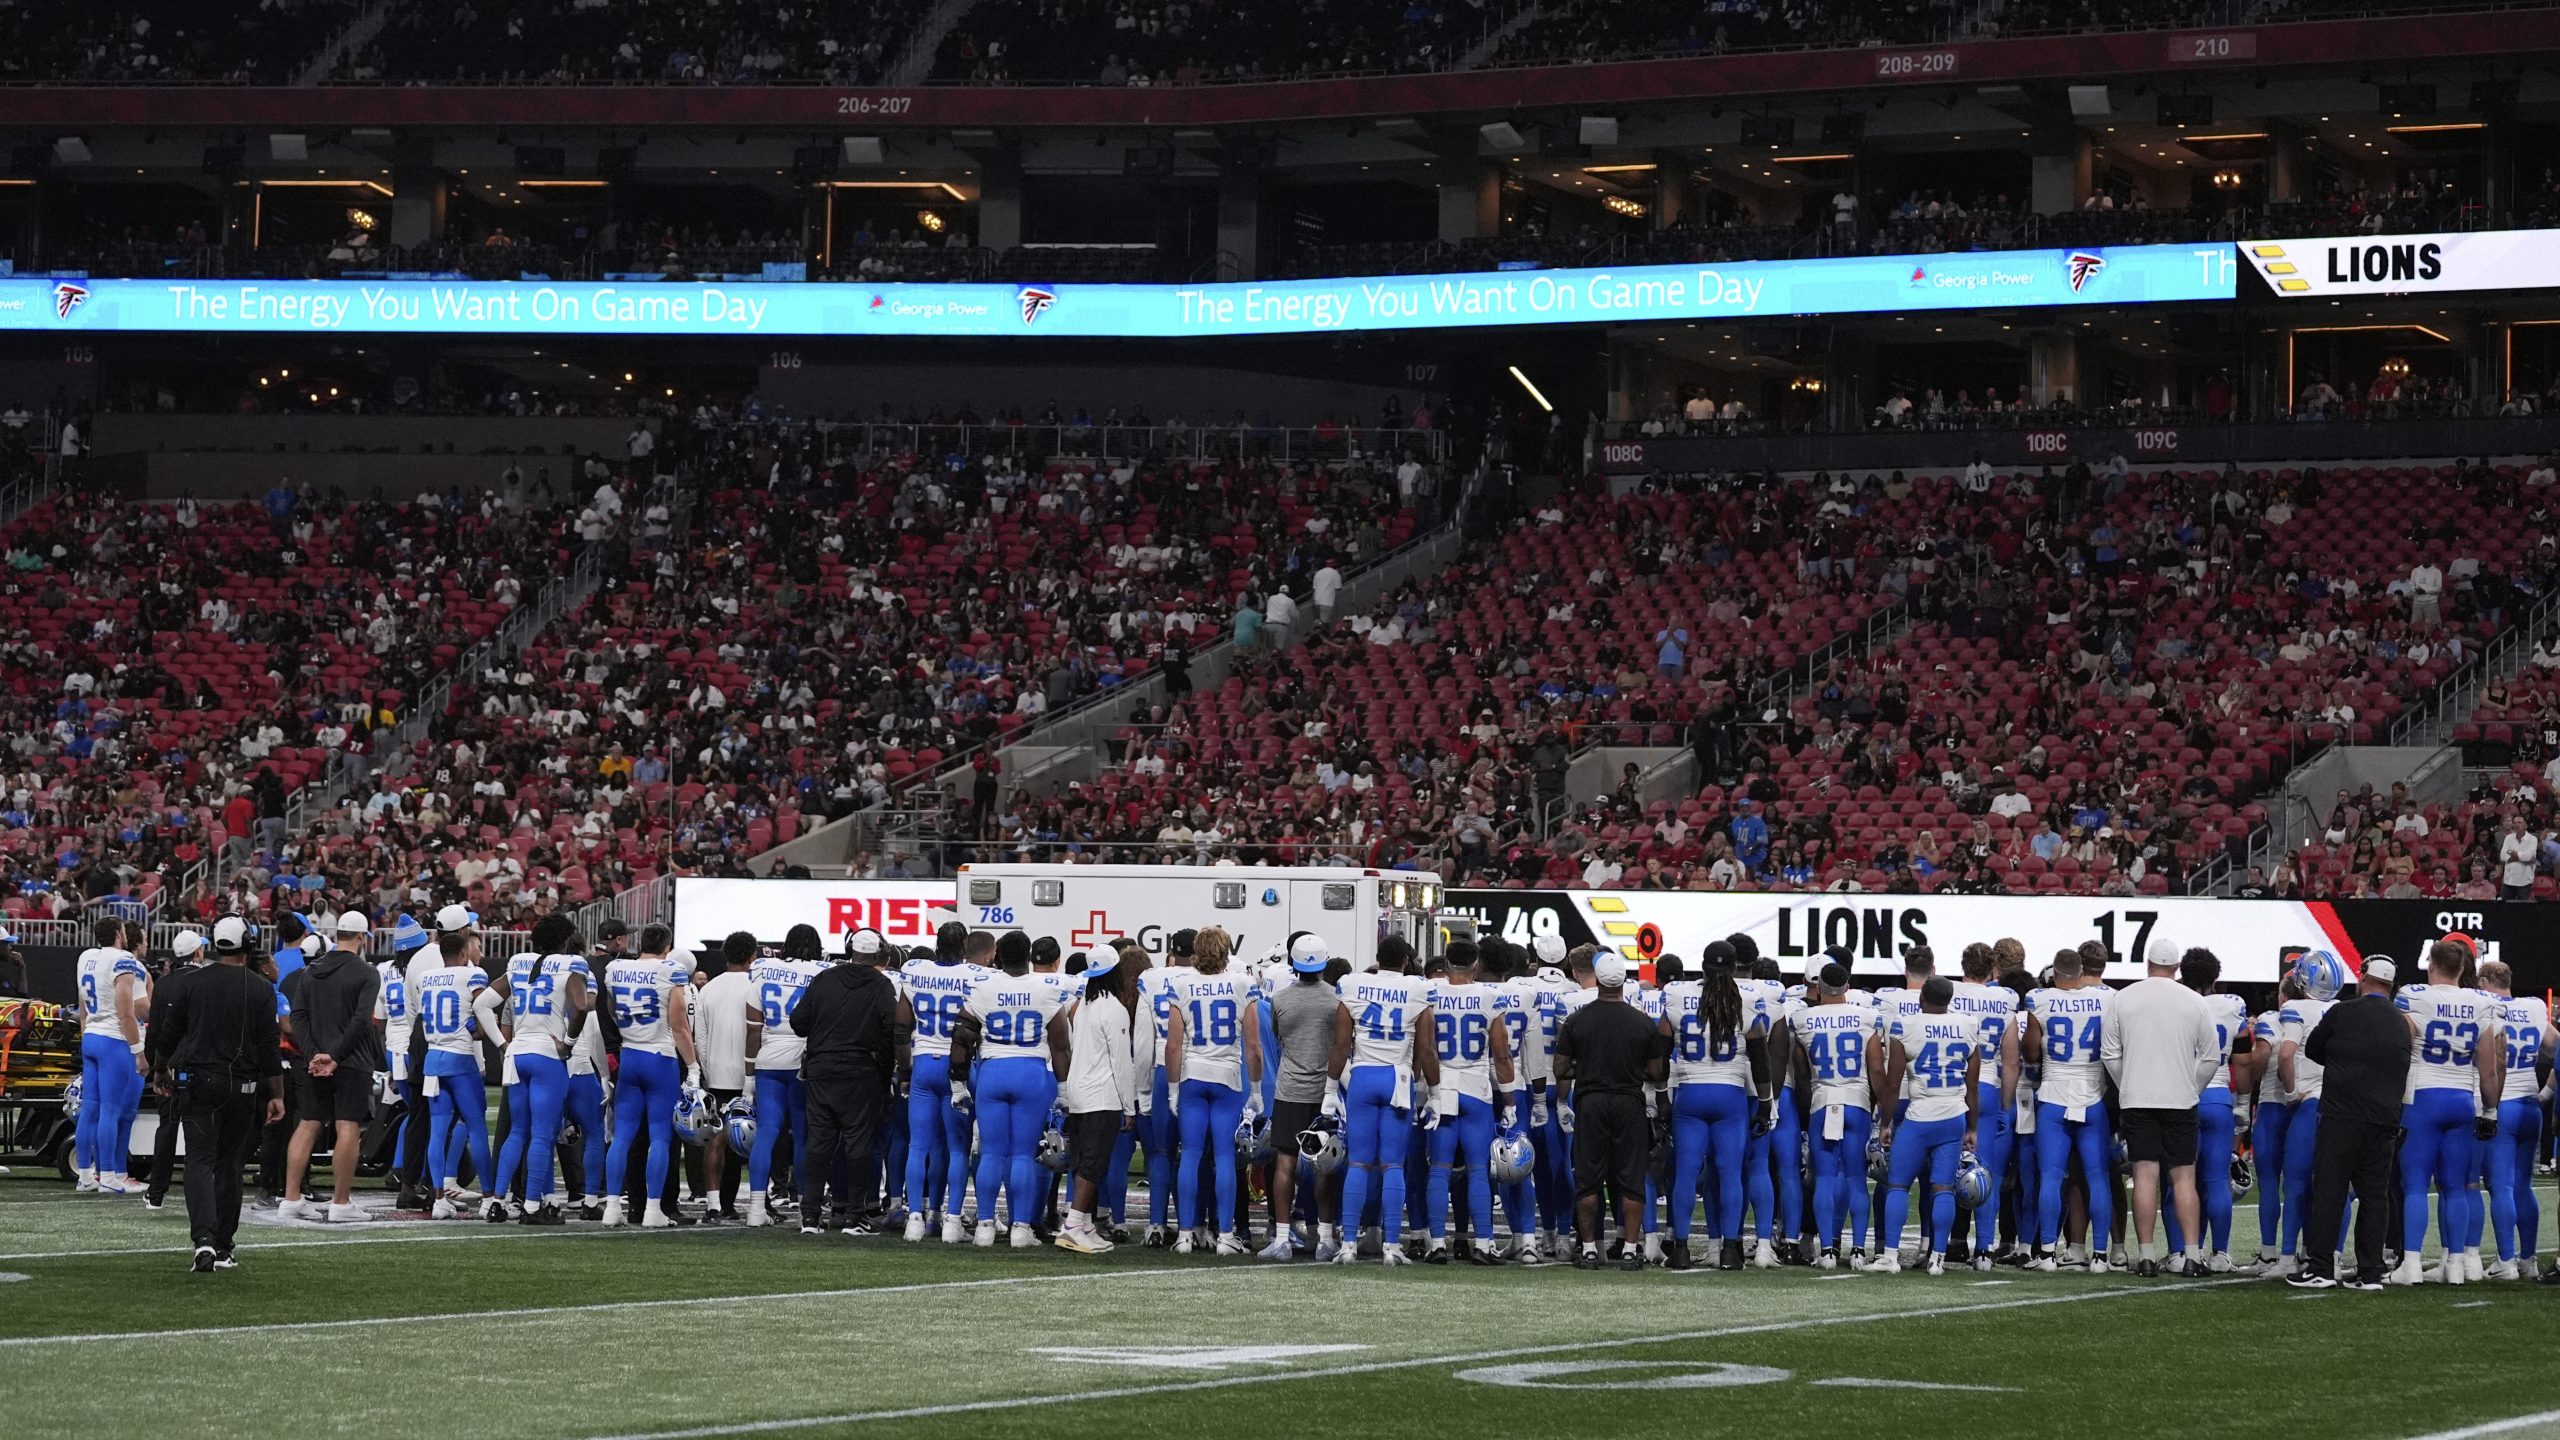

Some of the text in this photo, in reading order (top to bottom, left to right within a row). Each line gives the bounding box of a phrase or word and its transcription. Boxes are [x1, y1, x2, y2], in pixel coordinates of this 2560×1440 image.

[2195, 38, 2229, 56] 210
[1879, 54, 1955, 74] 208-209
[838, 97, 911, 114] 206-207
[2328, 243, 2441, 283] LIONS
[1933, 270, 2035, 289] Georgia Power
[1178, 269, 1764, 327] The Energy You Want On Game Day
[170, 286, 768, 329] The Energy You Want On Game Day
[891, 300, 988, 319] Georgia Power
[64, 347, 93, 363] 105
[771, 353, 802, 369] 106
[1406, 365, 1437, 381] 107
[2026, 434, 2067, 452] 108C
[2134, 431, 2178, 450] 109C
[1604, 445, 1643, 463] 108C
[1974, 474, 1985, 488] 11
[667, 679, 681, 690] 21
[2544, 729, 2558, 745] 18
[436, 769, 449, 783] 18
[1416, 789, 1431, 804] 21
[1724, 872, 1731, 889] 7
[979, 907, 1013, 923] 786
[2436, 912, 2483, 931] QTR
[1778, 907, 1928, 958] LIONS
[2093, 910, 2158, 963] 17
[84, 960, 97, 972] FOX
[512, 960, 561, 974] CUNNINHAM
[422, 974, 454, 989] BARCOO
[612, 970, 656, 985] NOWASKE
[762, 967, 797, 984] COOPER
[81, 974, 98, 1015] 3
[997, 993, 1031, 1006] SMITH
[1358, 986, 1408, 1004] PITTMAN
[1438, 995, 1480, 1010] TAYLOR
[421, 990, 460, 1034] 40
[611, 986, 660, 1029] 53
[1954, 998, 2008, 1014] STILIANOS
[2049, 999, 2102, 1013] ZYLSTRA
[2437, 1004, 2474, 1019] MILLER
[985, 1010, 1043, 1047] 90
[1190, 1000, 1237, 1046] 18
[1359, 1003, 1405, 1041] 41
[1806, 1016, 1860, 1029] SAYLORS
[1437, 1013, 1488, 1061] 86
[1925, 1025, 1963, 1039] SMALL
[2047, 1016, 2102, 1062] 84
[2422, 1021, 2479, 1066] 63
[1809, 1032, 1863, 1079] 48
[1914, 1042, 1970, 1088] 42
